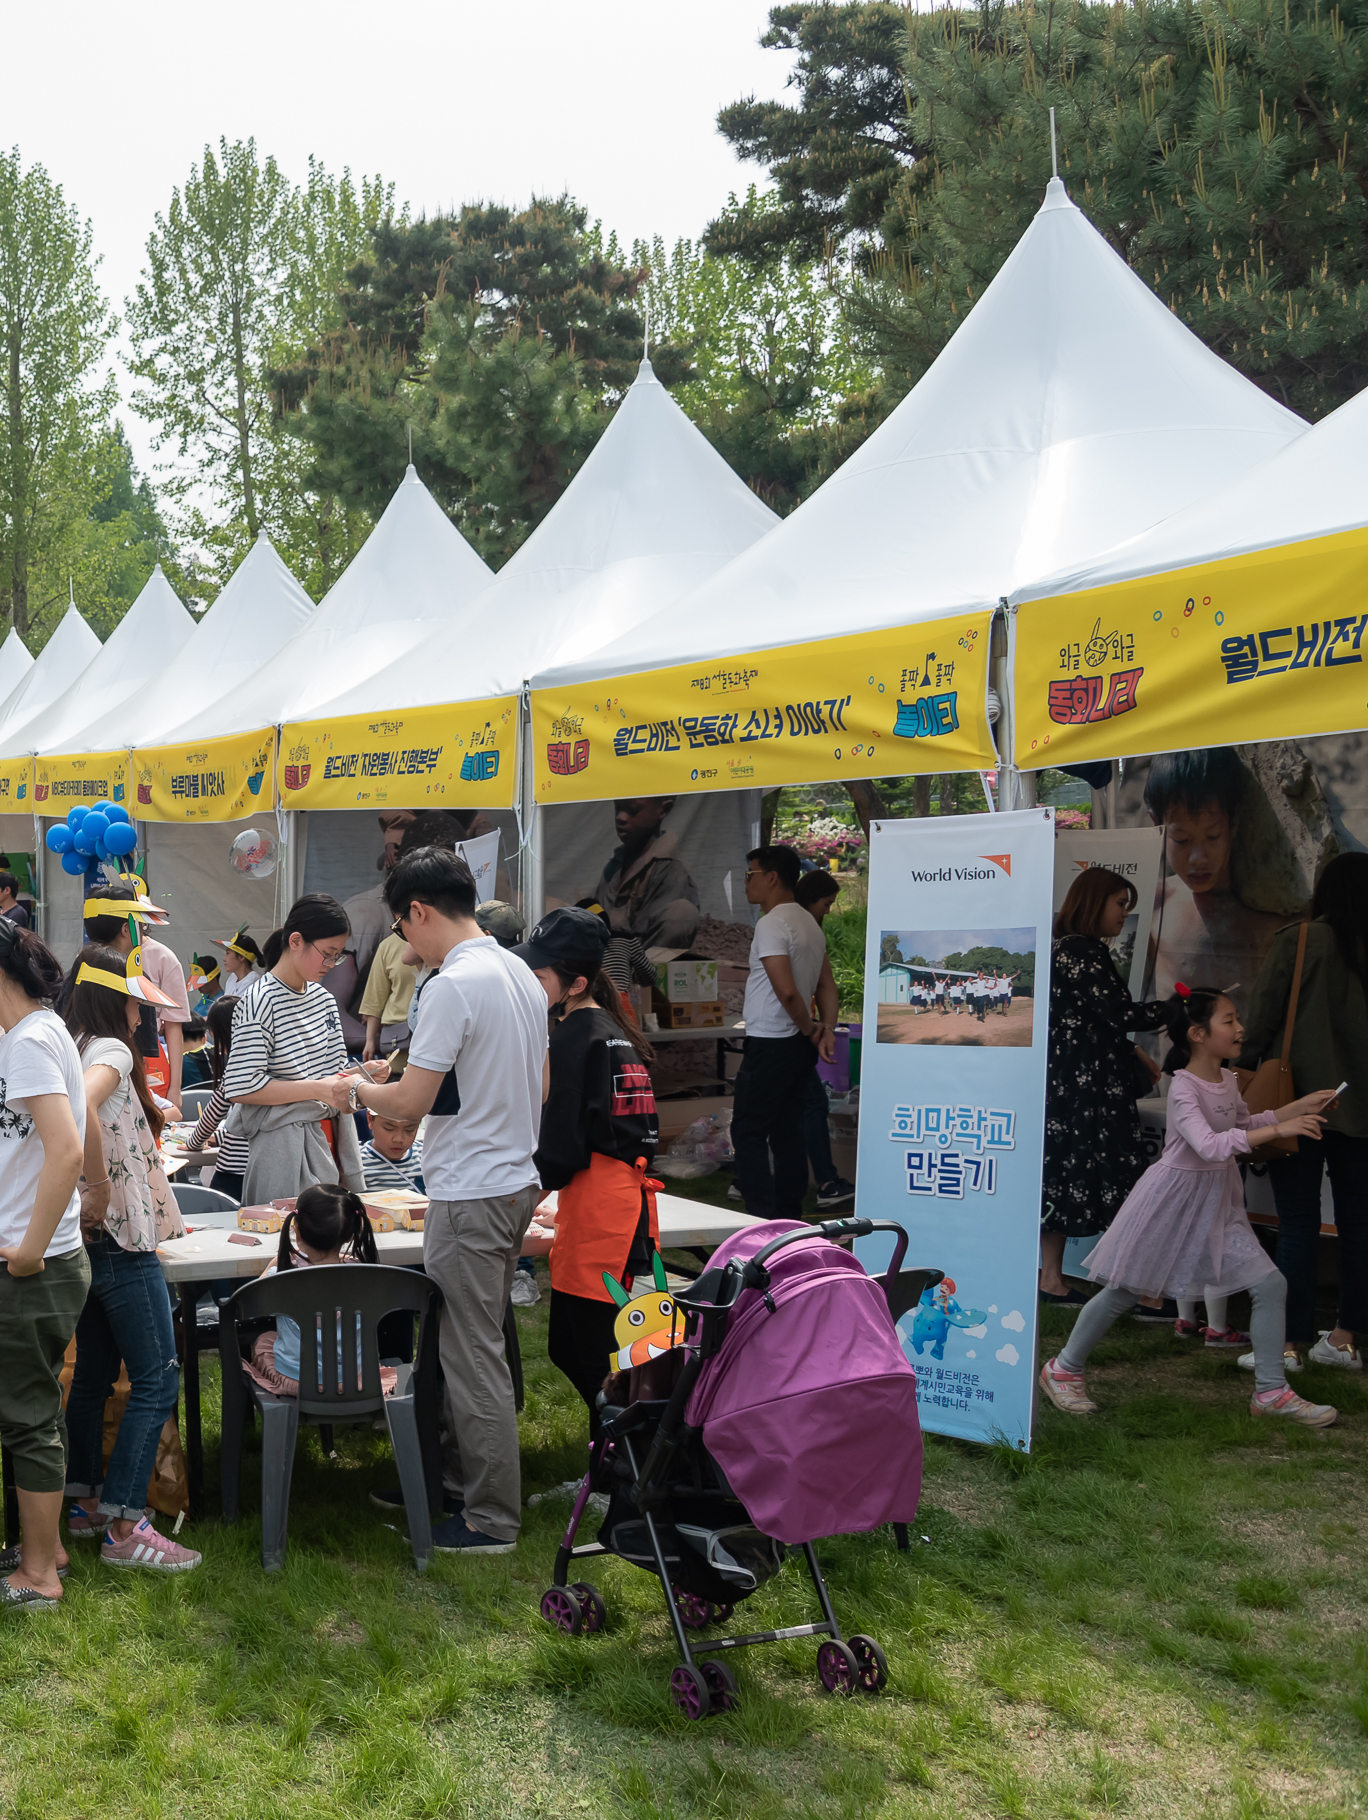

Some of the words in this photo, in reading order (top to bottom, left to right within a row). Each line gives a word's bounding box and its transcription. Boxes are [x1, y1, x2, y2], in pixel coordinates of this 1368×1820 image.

[1059, 642, 1081, 671] 와글
[1112, 633, 1135, 663] 와글
[1220, 614, 1368, 685] 월드비전
[691, 676, 711, 691] 제8회
[712, 668, 758, 690] 서울동화축제
[900, 667, 919, 692] 폴짝
[935, 661, 955, 687] 폴짝
[613, 720, 681, 757] 월드비전
[739, 706, 783, 743] 소녀
[323, 753, 360, 779] 월드비전
[171, 773, 199, 799] 부루마불
[200, 771, 225, 797] 씨앗사
[911, 868, 952, 882] World
[954, 867, 996, 881] Vision
[890, 1105, 1014, 1152] 희망학교
[906, 1151, 994, 1196] 만들기
[935, 1367, 980, 1387] 월드비전은
[923, 1393, 971, 1412] 노력합니다.
[975, 1388, 994, 1403] 위해
